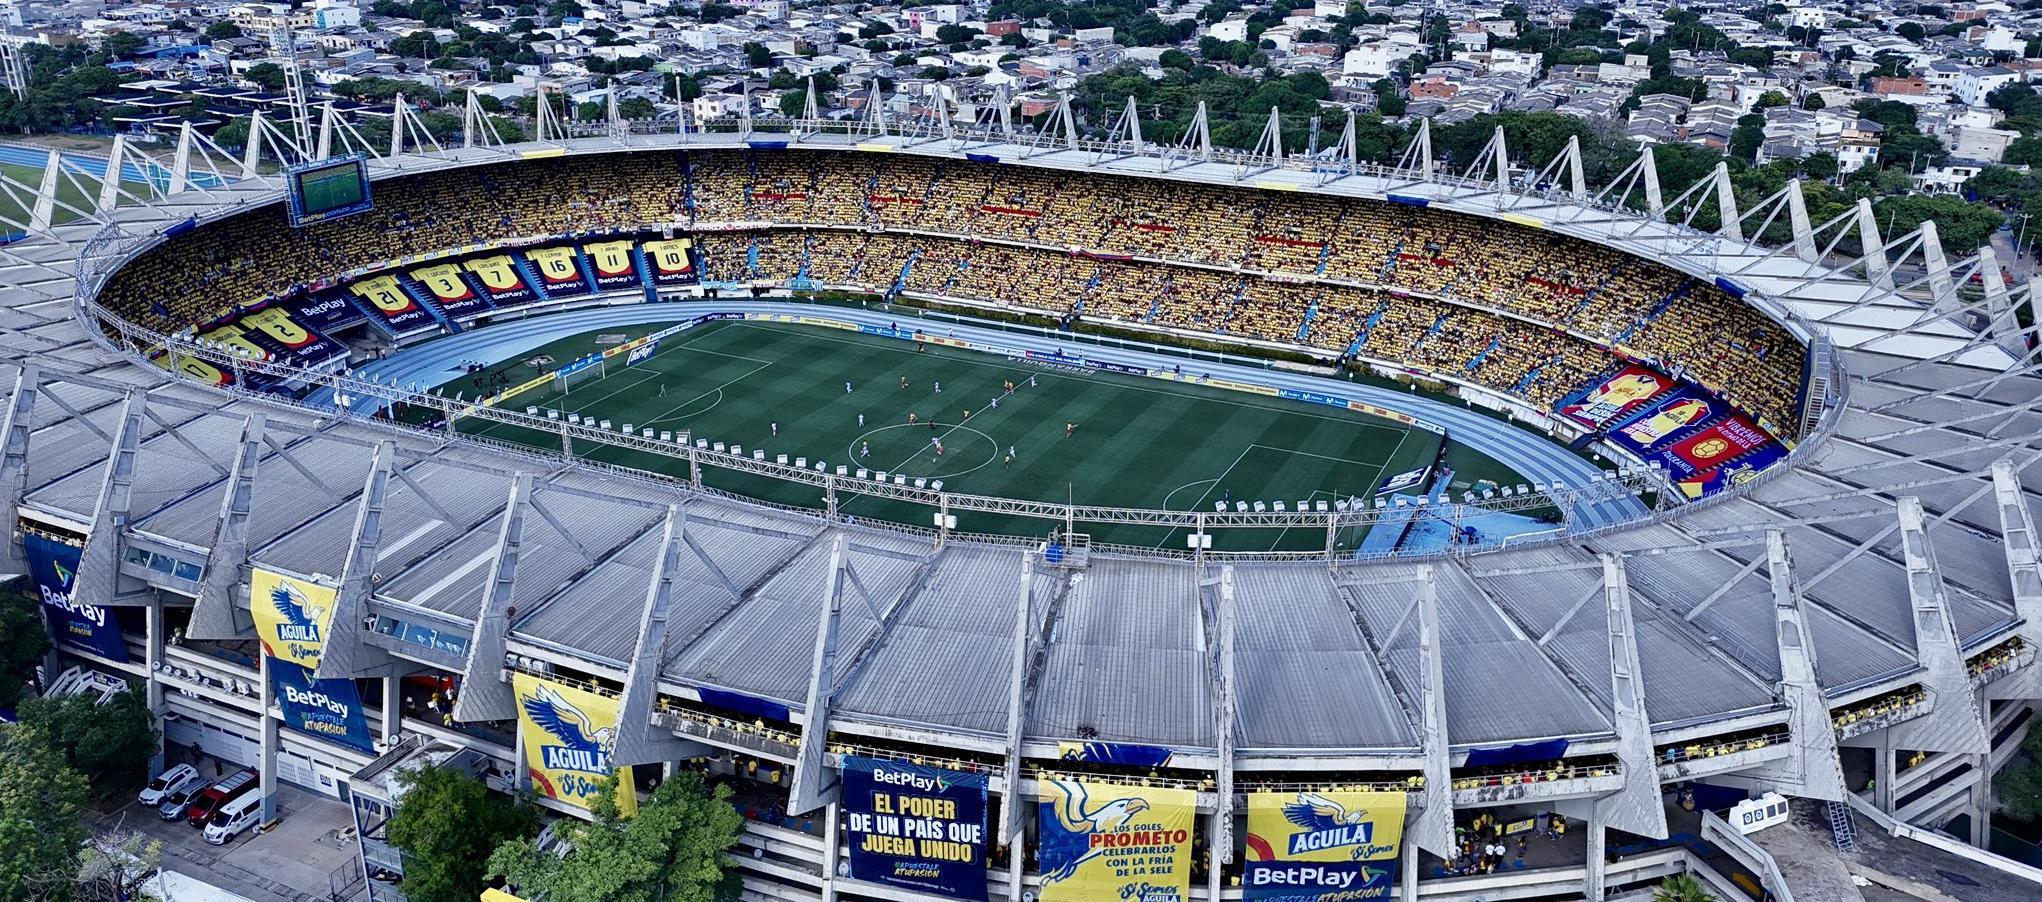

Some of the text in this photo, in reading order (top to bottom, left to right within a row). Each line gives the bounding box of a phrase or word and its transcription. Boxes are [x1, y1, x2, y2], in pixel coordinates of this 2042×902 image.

[550, 259, 566, 273] 16
[608, 254, 618, 266] 11
[666, 253, 680, 265] 10
[439, 278, 453, 291] 3
[490, 270, 501, 283] 7
[376, 290, 398, 304] 21
[301, 298, 346, 316] BetPlay
[273, 324, 295, 337] 2
[1726, 418, 1766, 445] VIBREMOS
[281, 624, 318, 640] AGUILA
[285, 685, 348, 719] BetPlay
[873, 768, 935, 792] BetPlay
[875, 793, 955, 820] EL PODER
[850, 812, 981, 844] DE UN PAÍS QUE
[1090, 829, 1187, 849] PROMETO
[1292, 824, 1368, 853] AGUILA
[861, 834, 972, 862] JUEGA UNIDO
[1102, 844, 1176, 857] CELEBRARLOS
[1106, 854, 1173, 867] CON LA FRÍA
[1116, 866, 1173, 877] DE LA SELE
[1253, 866, 1357, 888] BetPlay
[1136, 881, 1179, 898] Somos
